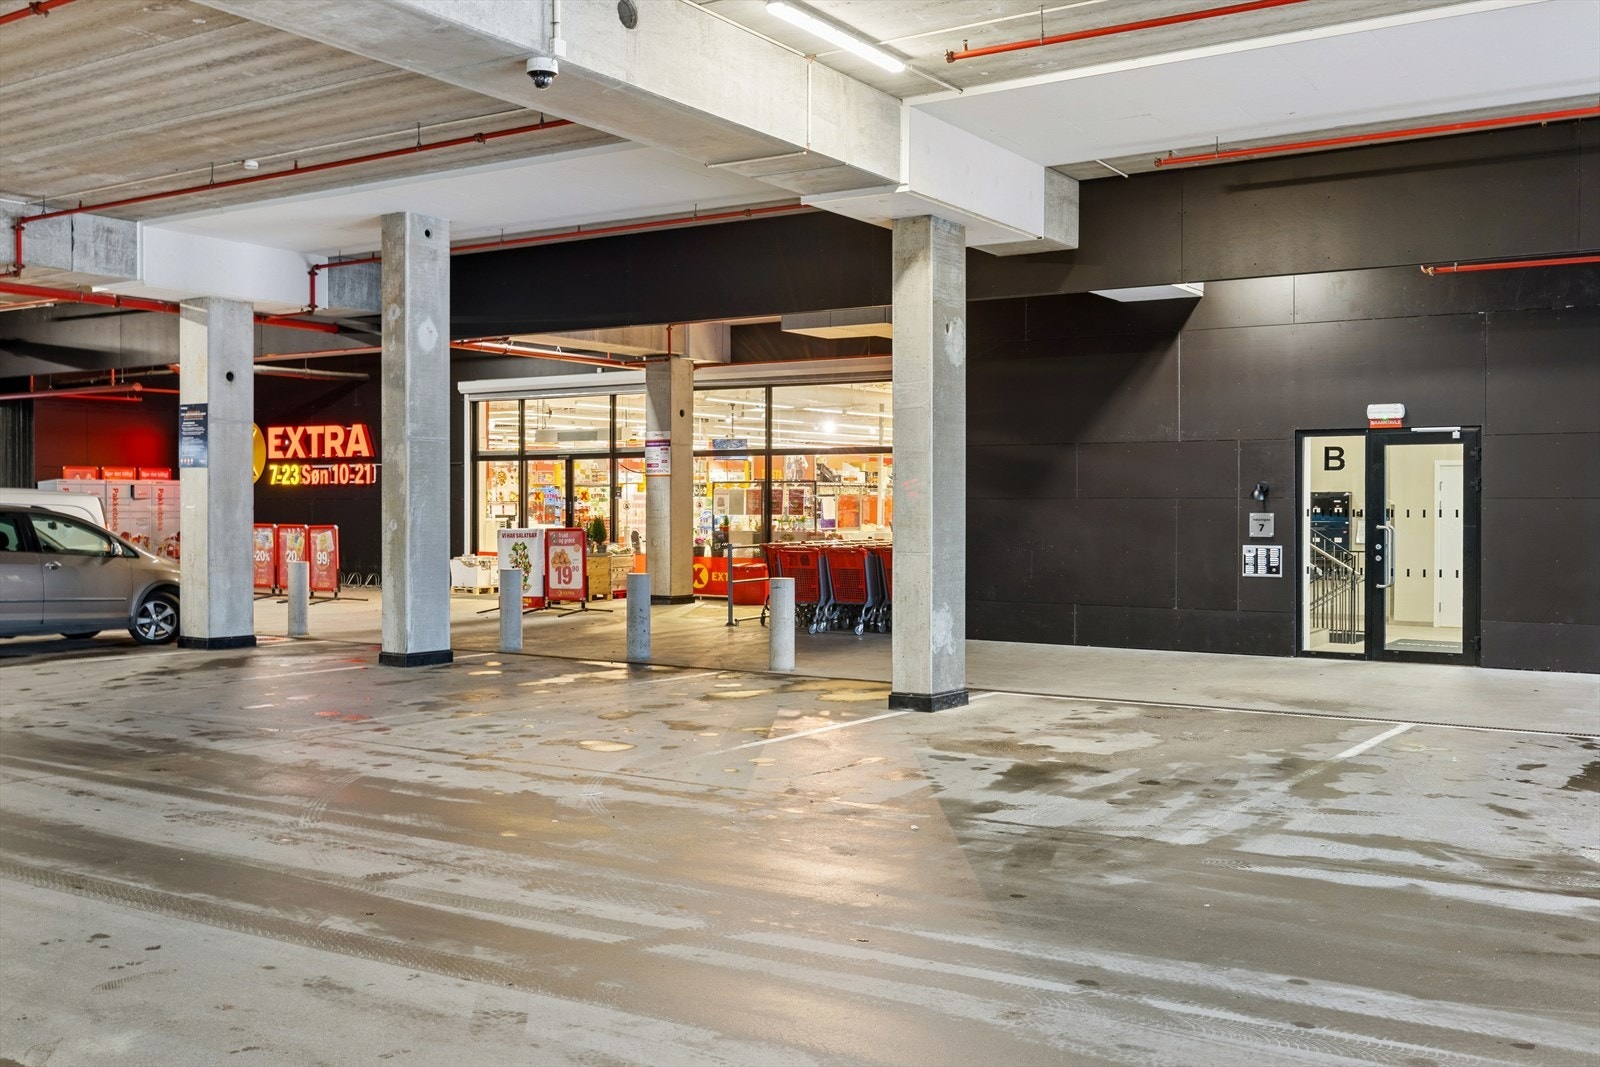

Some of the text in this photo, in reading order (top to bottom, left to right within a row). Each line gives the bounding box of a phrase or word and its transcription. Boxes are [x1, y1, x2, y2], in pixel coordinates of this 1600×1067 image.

[268, 424, 370, 459] EXTRA
[1323, 446, 1346, 471] B
[269, 463, 372, 485] 7-23 Søn 10-21
[1258, 523, 1265, 532] 7
[555, 566, 573, 585] 19
